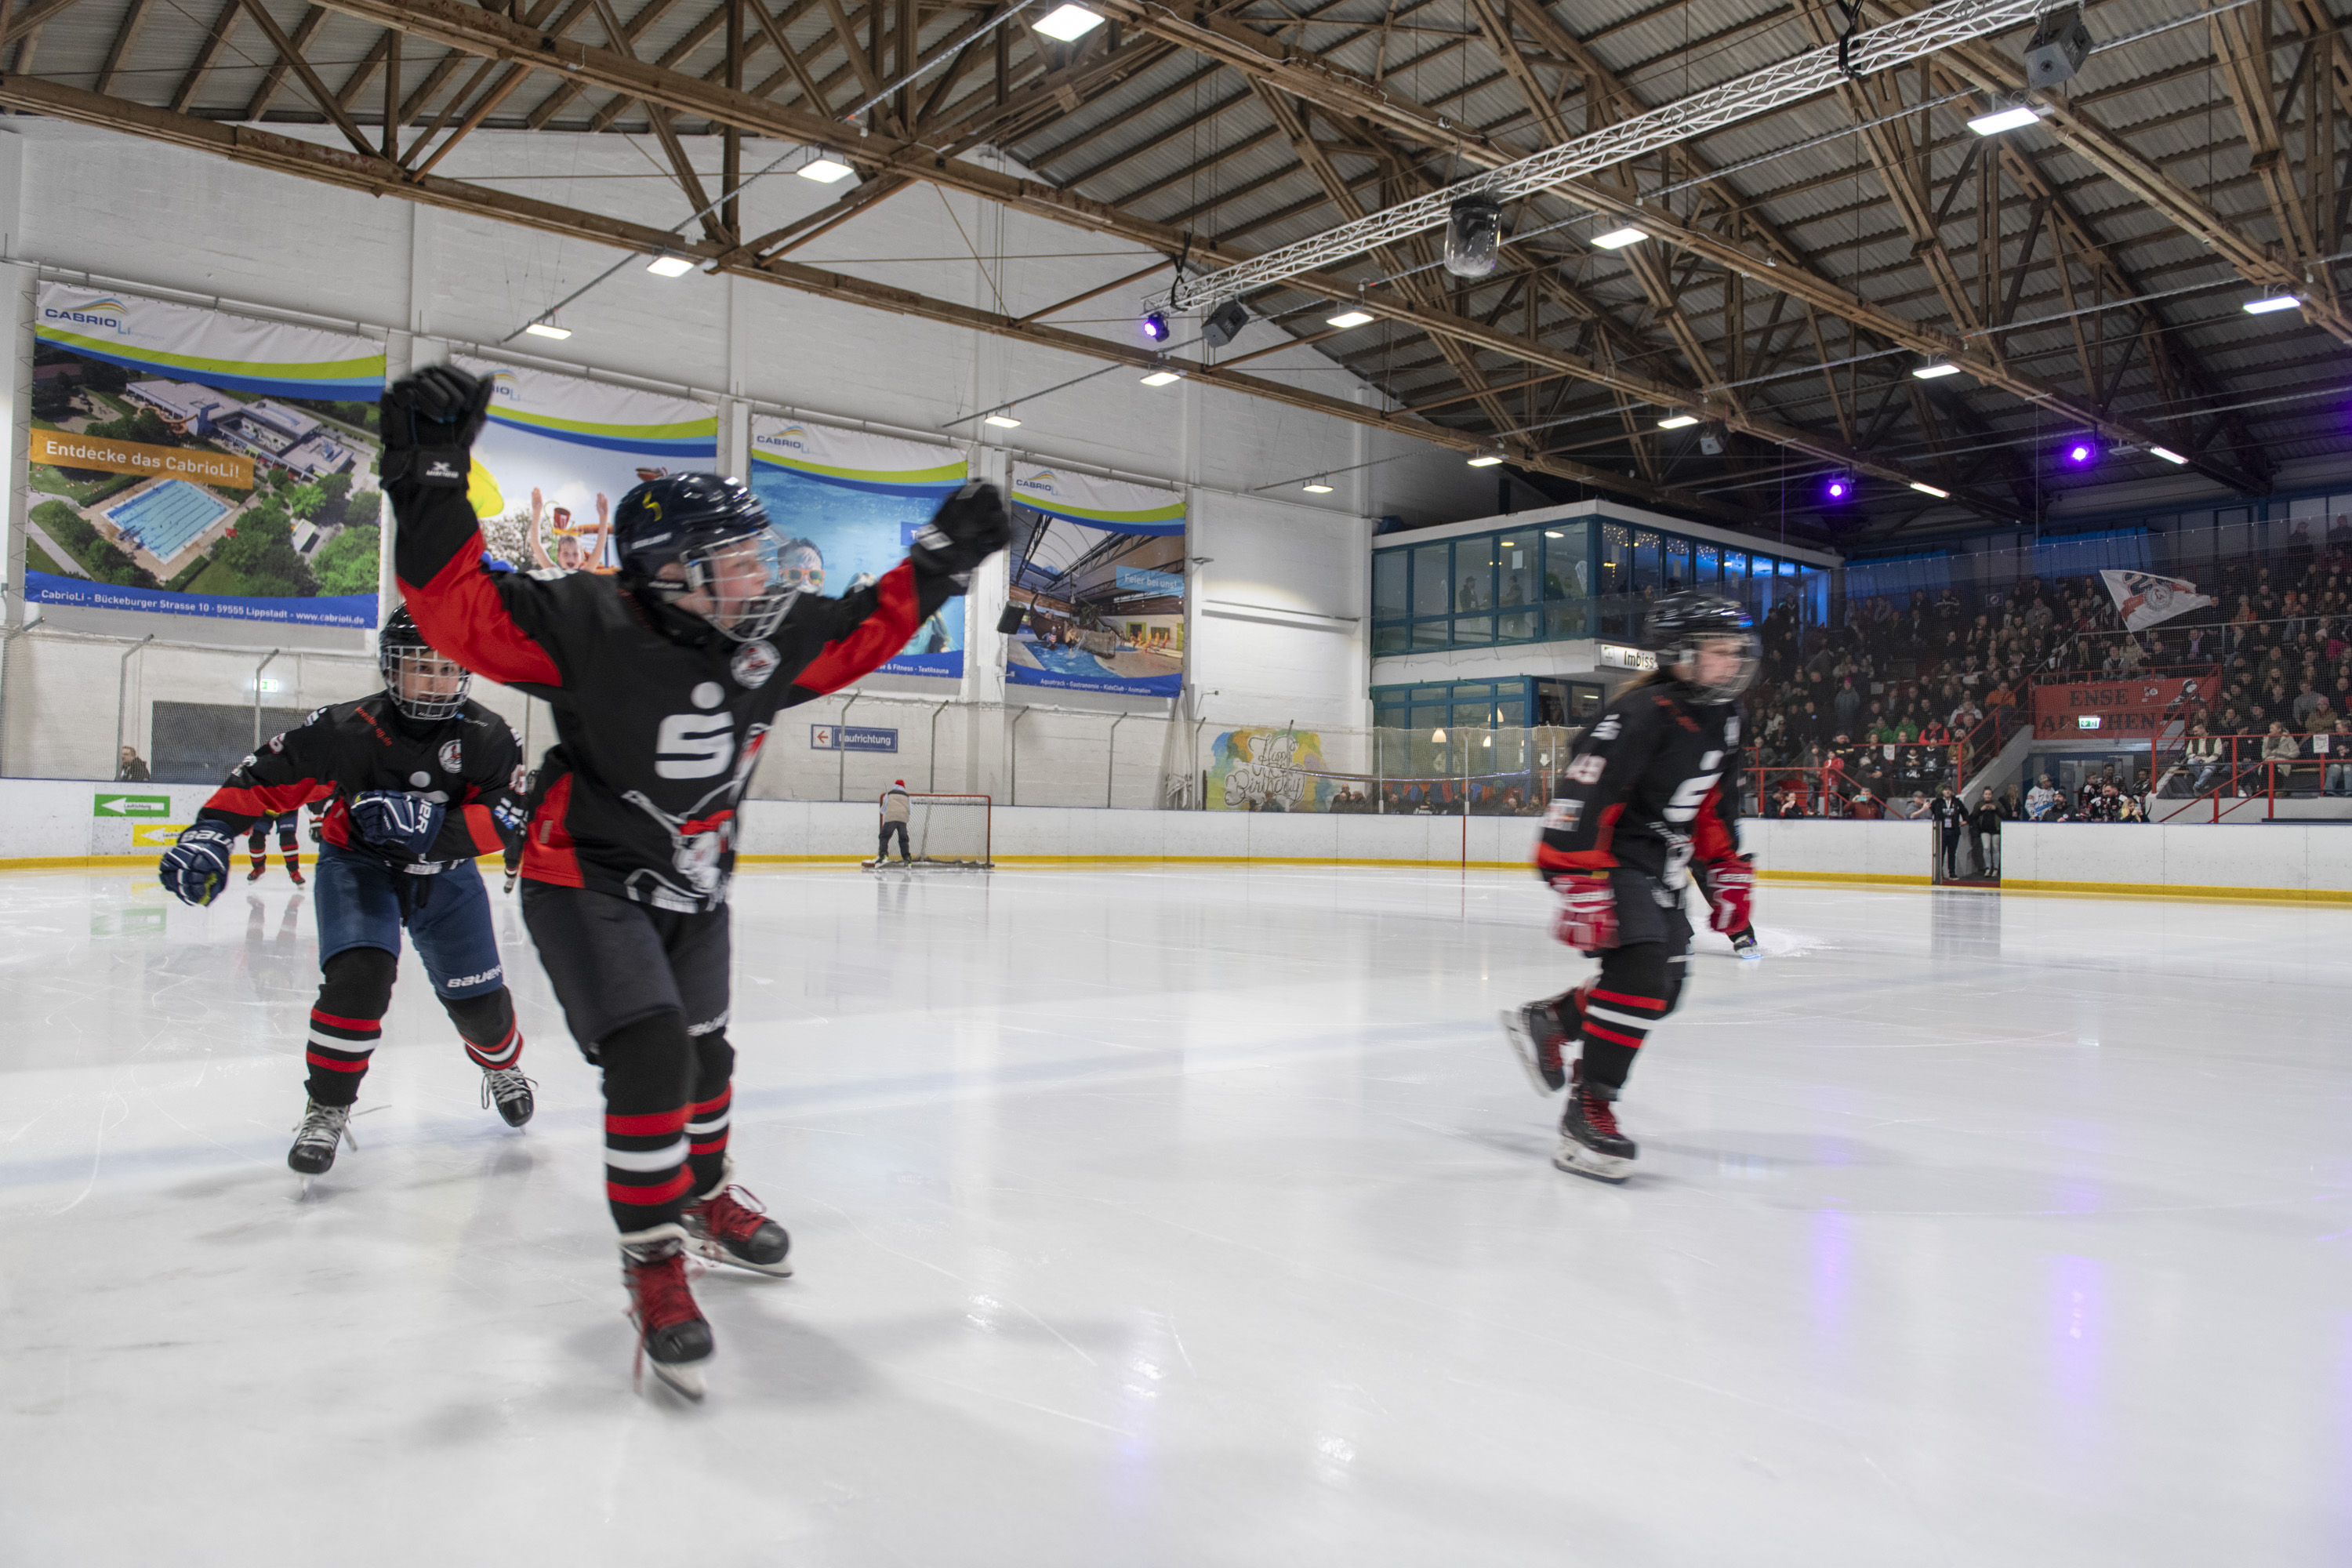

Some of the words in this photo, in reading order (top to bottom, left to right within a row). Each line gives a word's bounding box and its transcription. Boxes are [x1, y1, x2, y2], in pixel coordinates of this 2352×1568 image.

[46, 441, 126, 463] Entdecke
[132, 452, 161, 467] das
[165, 456, 239, 478] CabrioLi!
[1124, 573, 1145, 585] Feier
[1146, 577, 1159, 586] bei
[1160, 579, 1177, 589] uns!
[41, 590, 85, 601] CabrioLi
[94, 593, 158, 608] Bückeburger
[159, 599, 196, 611] Strasse
[198, 603, 209, 612] 10
[216, 604, 245, 615] 59555
[245, 607, 288, 619] Lippstadt
[296, 612, 365, 625] www.cabrioli.de
[1624, 650, 1654, 668] Imbiss
[892, 663, 913, 672] Fitness
[918, 666, 949, 674] Textilsauna
[1040, 678, 1065, 687] Aquatrack
[2070, 688, 2129, 706] ENSE
